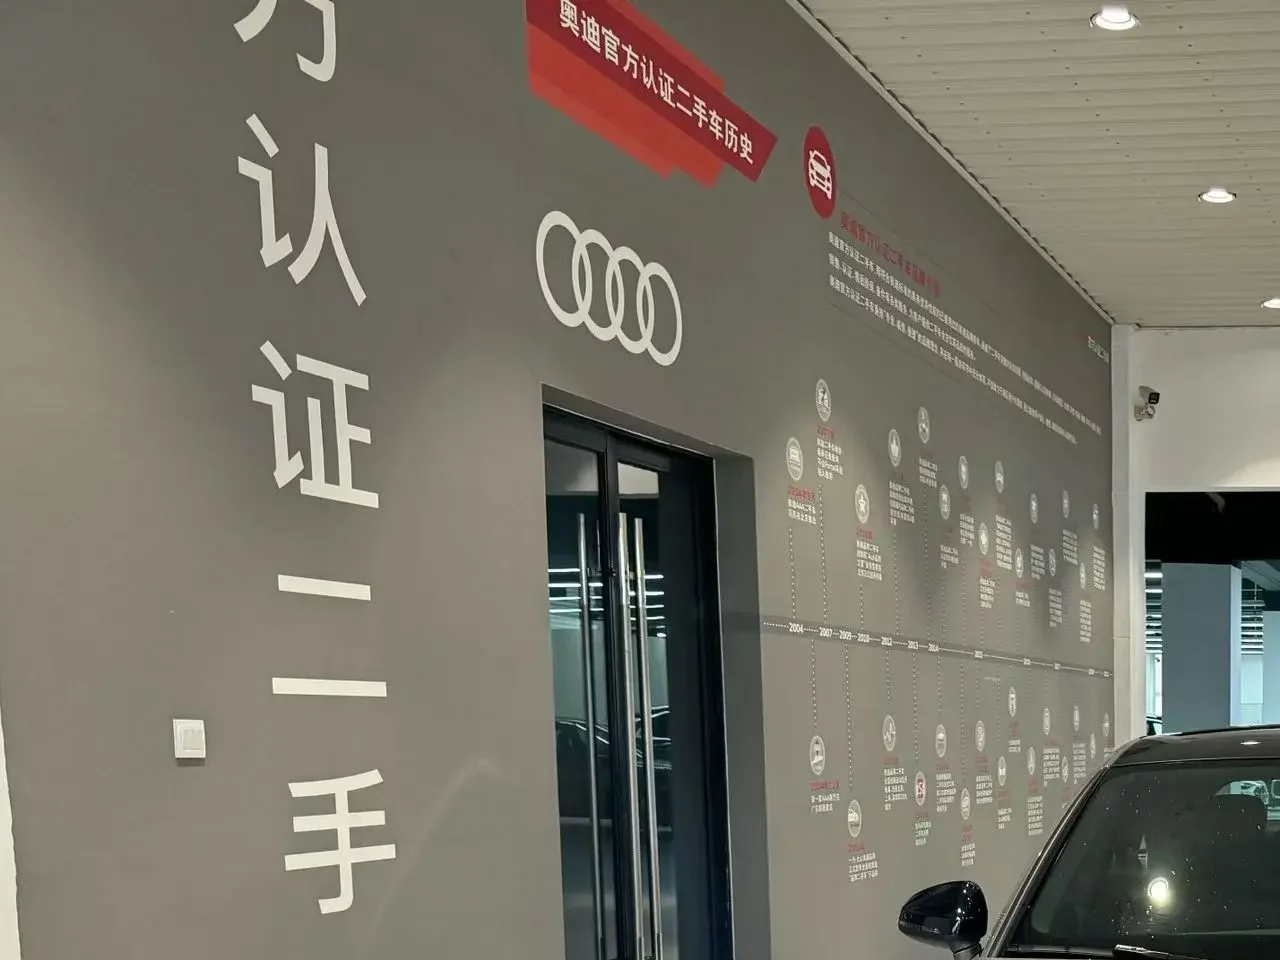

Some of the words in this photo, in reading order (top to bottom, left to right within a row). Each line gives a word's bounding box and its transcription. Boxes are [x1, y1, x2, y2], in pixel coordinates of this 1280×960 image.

[560, 0, 754, 164] 奥迪官方认证二手车历史
[788, 622, 804, 633] 2004
[819, 626, 833, 638] 2007
